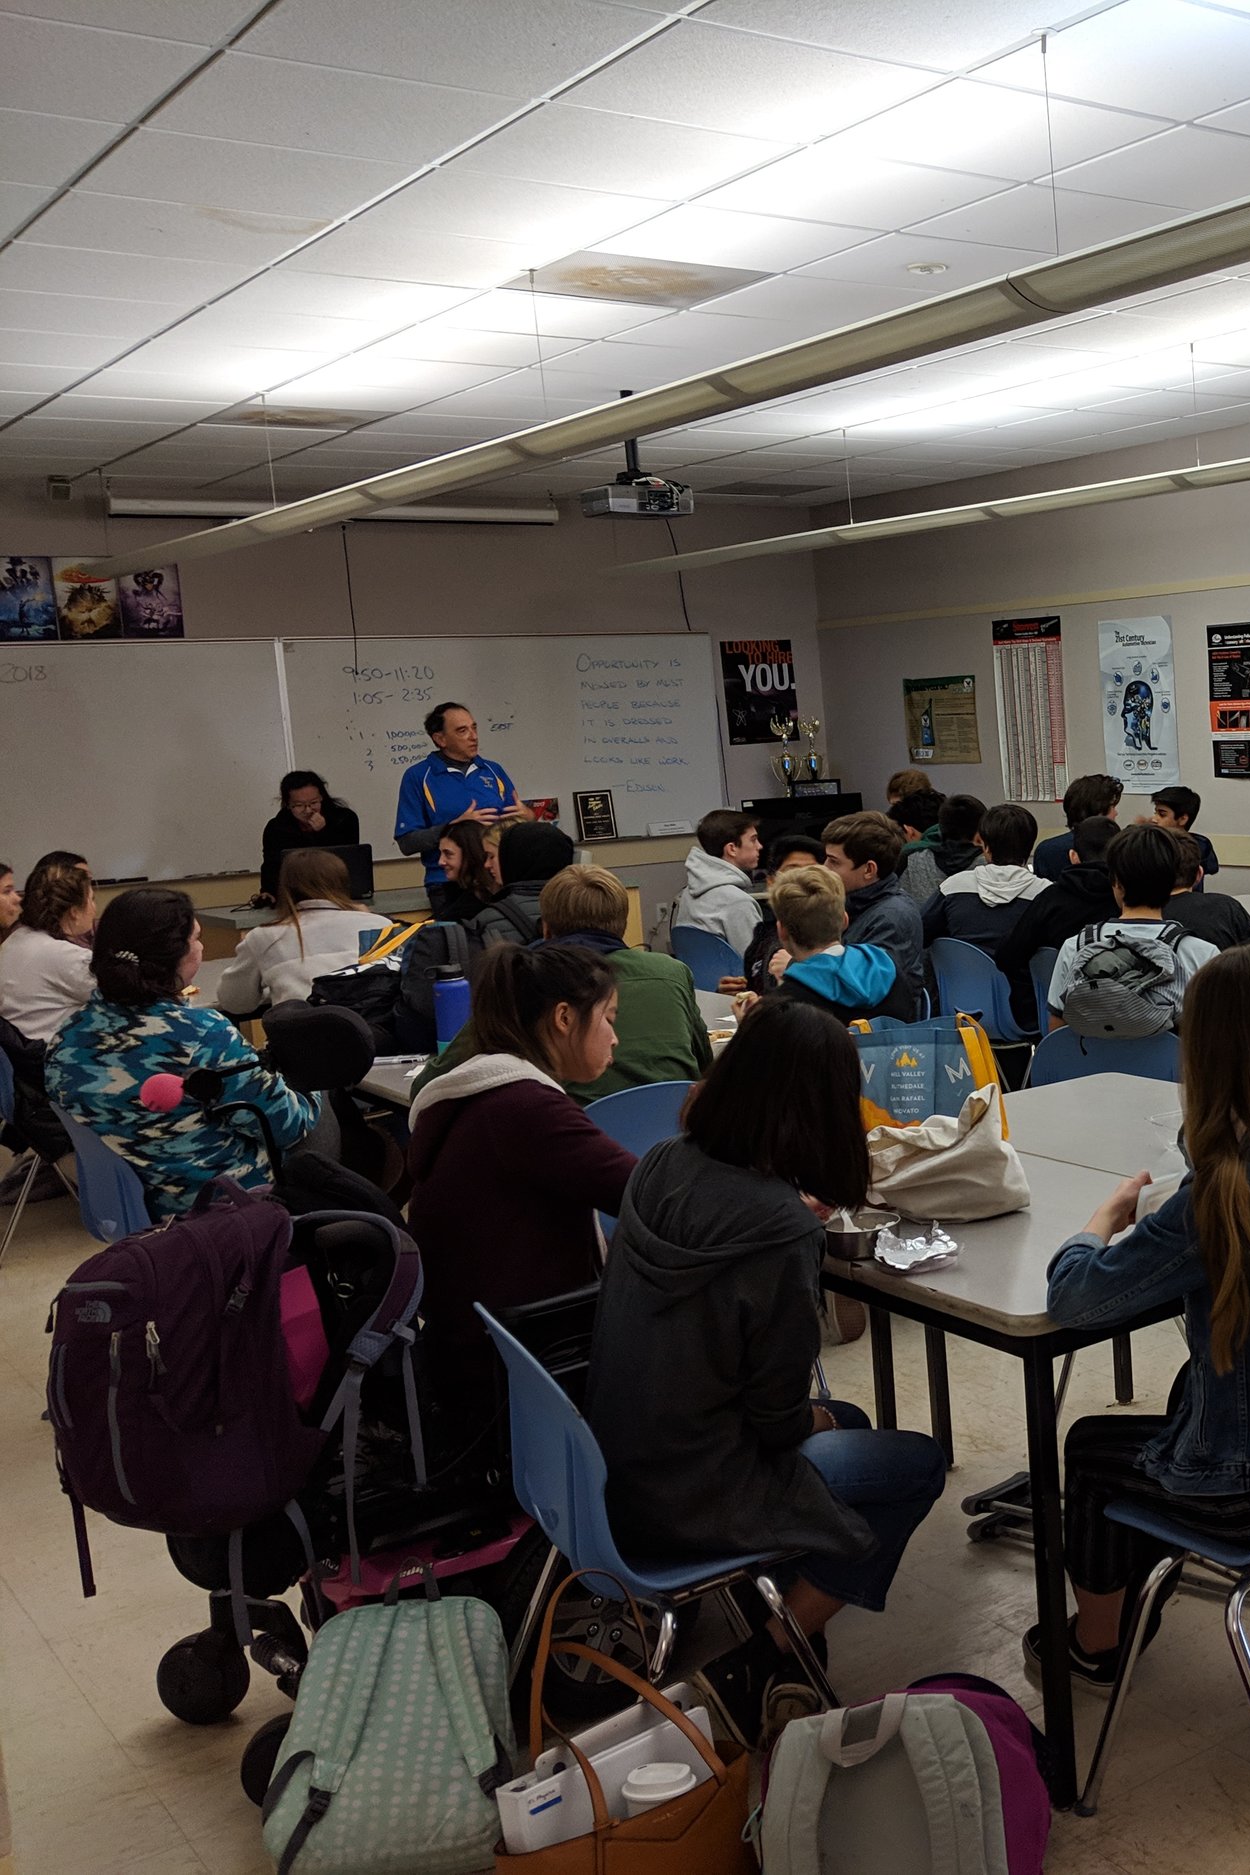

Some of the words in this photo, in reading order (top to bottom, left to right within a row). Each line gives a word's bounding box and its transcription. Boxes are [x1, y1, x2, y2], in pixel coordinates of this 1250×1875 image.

[1126, 634, 1145, 642] Century
[725, 640, 780, 654] LOOKING
[748, 652, 762, 664] TO
[766, 651, 793, 664] HIRE
[0, 662, 48, 684] 2018
[738, 663, 796, 692] YOU.
